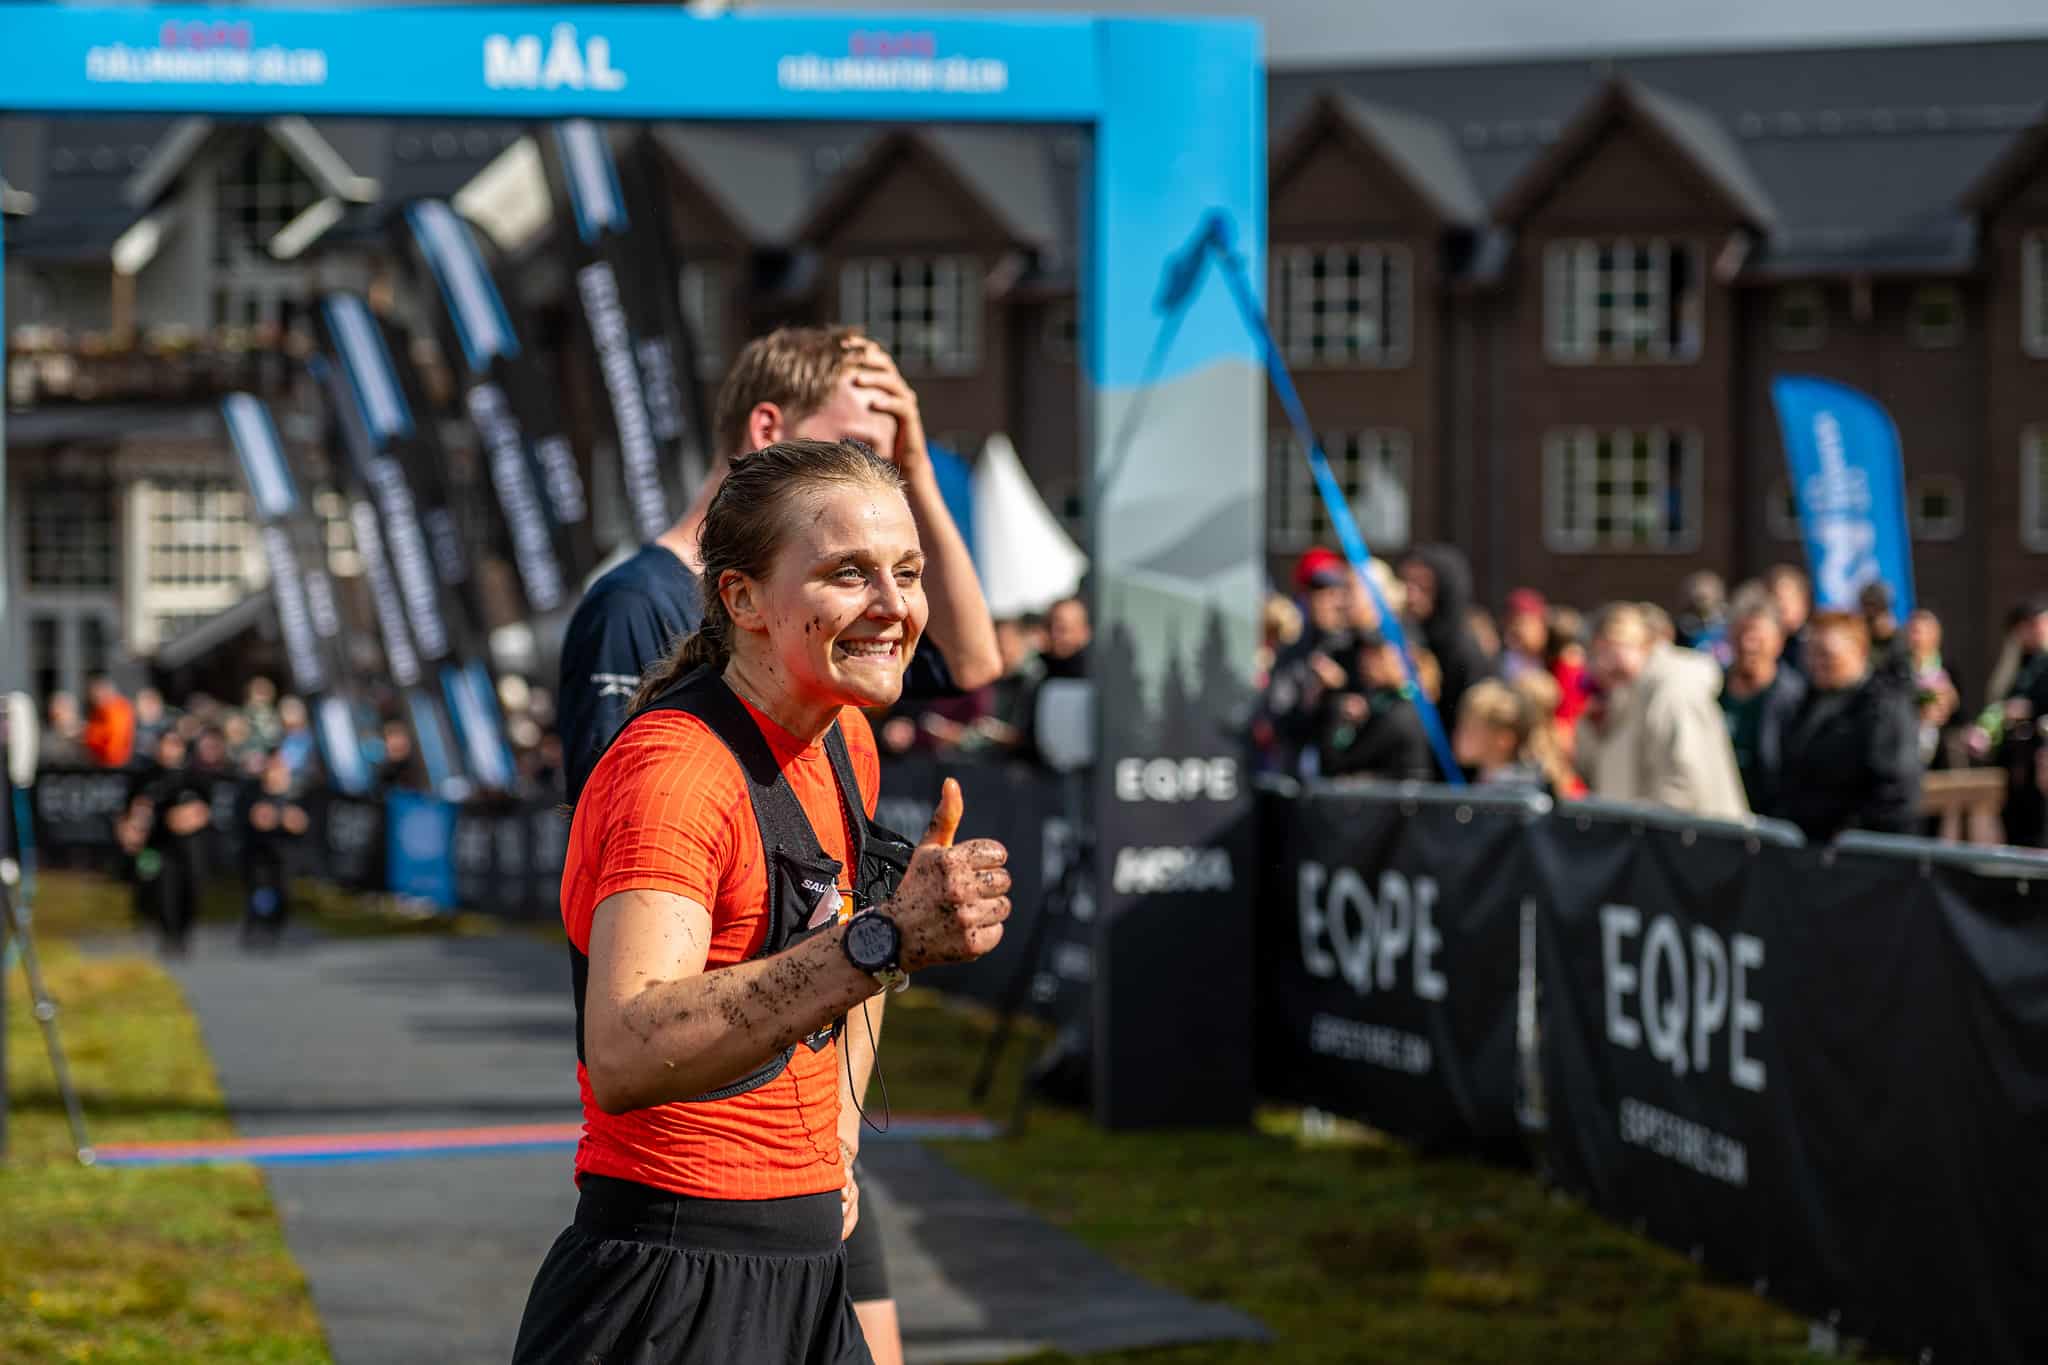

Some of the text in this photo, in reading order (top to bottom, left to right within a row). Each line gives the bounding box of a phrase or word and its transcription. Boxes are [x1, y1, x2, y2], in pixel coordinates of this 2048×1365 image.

[484, 22, 628, 91] MÅL
[1116, 757, 1238, 802] EQPE
[1299, 861, 1447, 1000] EQPE
[1601, 904, 1767, 1092] EQPE
